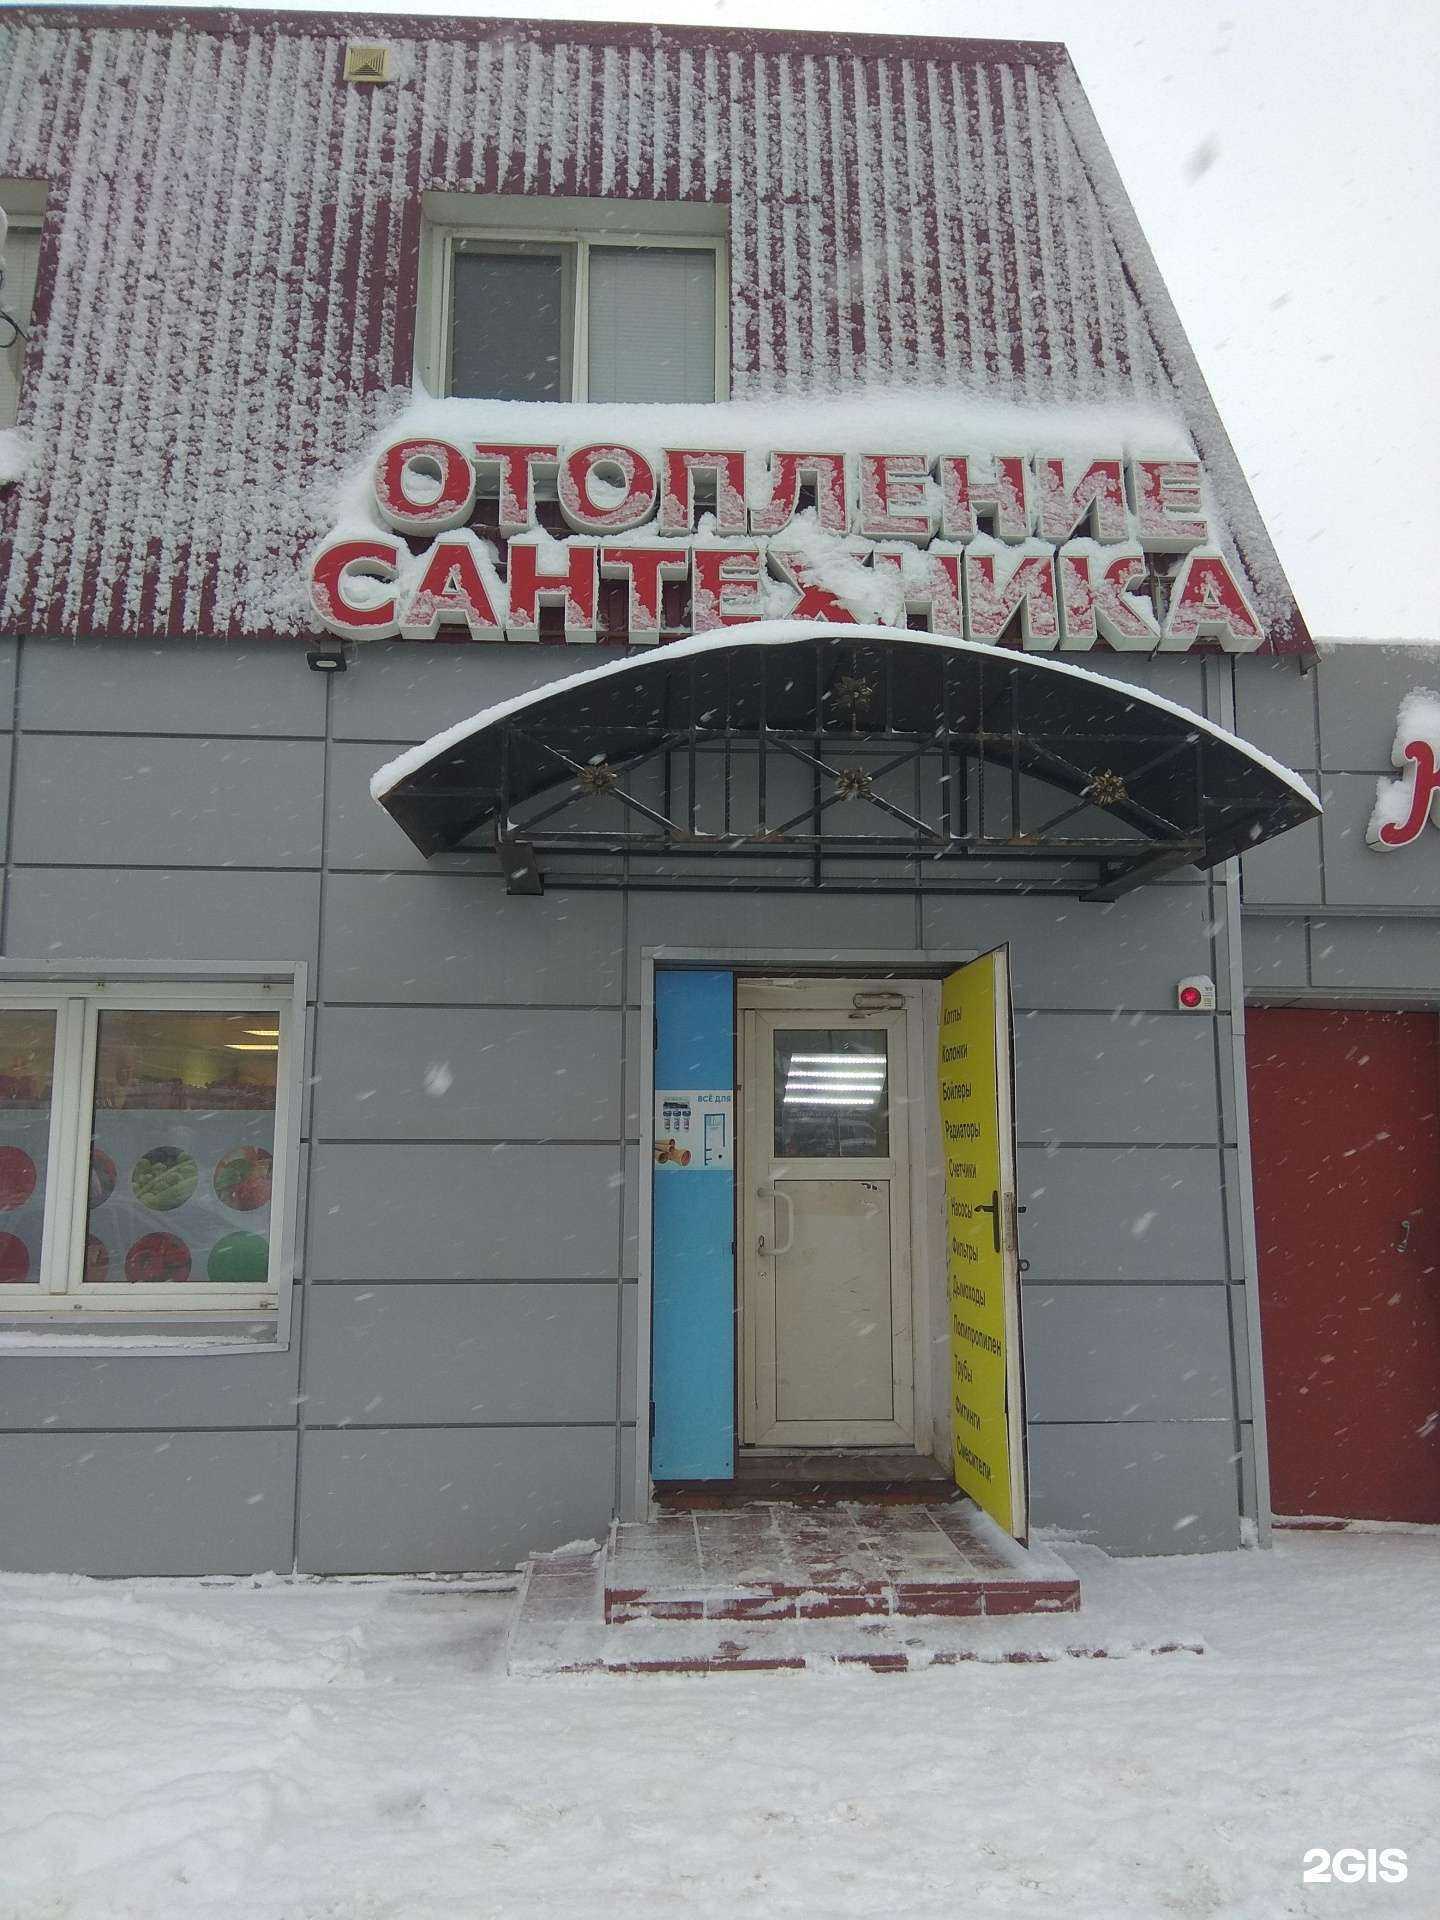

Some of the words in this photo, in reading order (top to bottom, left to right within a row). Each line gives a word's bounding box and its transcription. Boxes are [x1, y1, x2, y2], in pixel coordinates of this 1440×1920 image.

[377, 437, 1208, 546] ОТОПЛЕНИЕ
[943, 1007, 962, 1026] Котлы
[942, 1043, 968, 1065] Колонки
[714, 1095, 731, 1104] ДЛЯ
[942, 1081, 972, 1102] Бойлеры
[944, 1119, 981, 1143] Радиаторы
[948, 1158, 977, 1180] Счетчики
[951, 1197, 974, 1219] Насосы
[952, 1236, 979, 1264] Фильтры
[952, 1275, 986, 1308] Дымоходы
[953, 1314, 1002, 1357] Полипропилен
[954, 1353, 973, 1383] Трубы
[955, 1395, 981, 1431] Фитинги
[956, 1435, 992, 1483] Смесители
